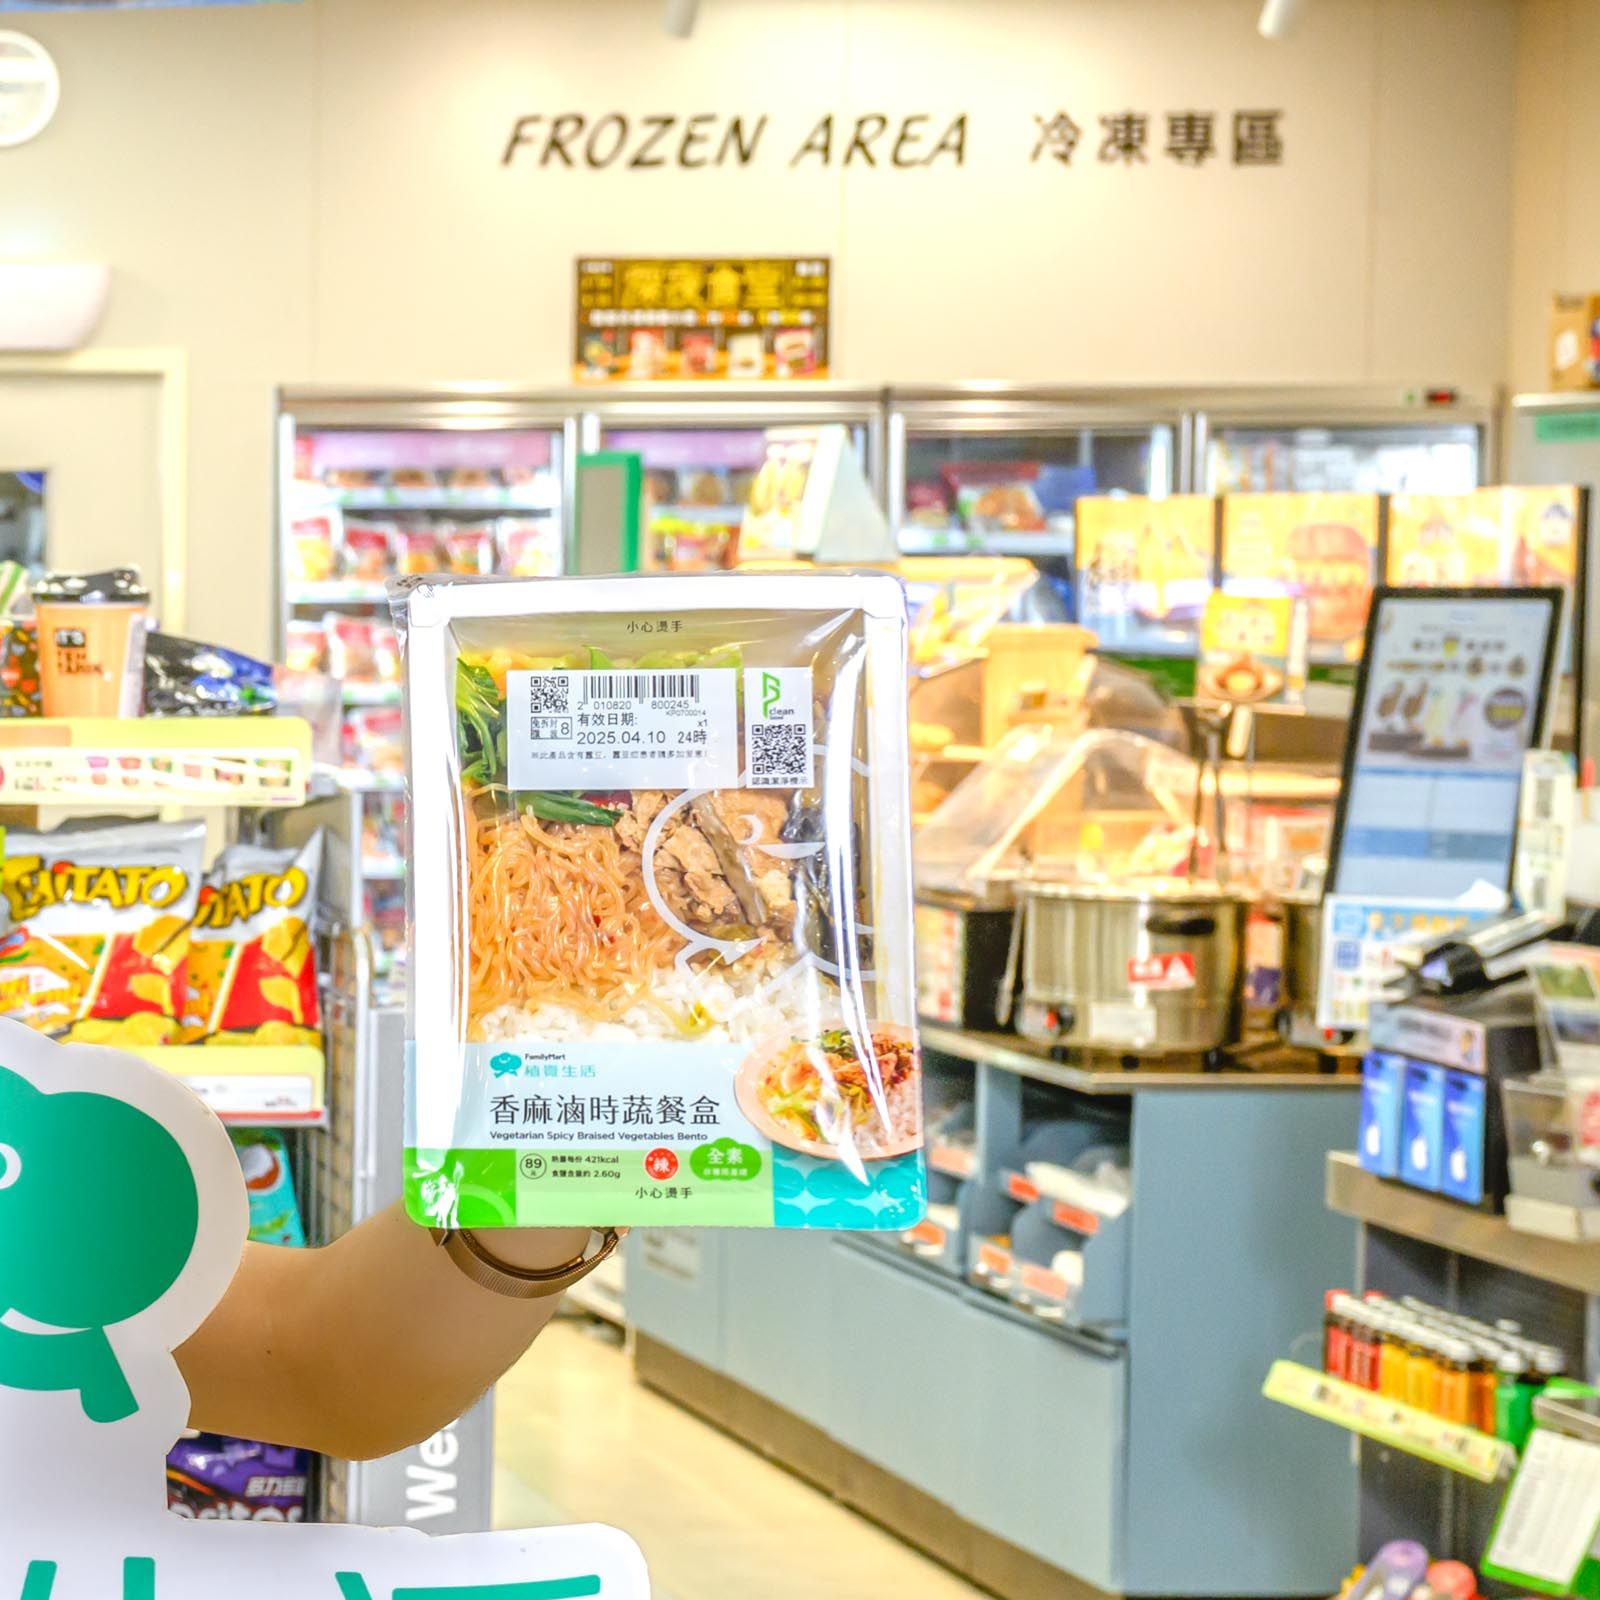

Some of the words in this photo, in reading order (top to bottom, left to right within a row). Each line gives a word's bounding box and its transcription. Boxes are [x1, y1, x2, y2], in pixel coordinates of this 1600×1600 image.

[501, 112, 769, 170] FROZEN
[789, 112, 971, 169] AREA
[1029, 110, 1286, 168] 冷凍專區
[576, 712, 639, 728] 有效日期:
[576, 730, 666, 745] 2025.04.10
[677, 730, 708, 745] 24時
[524, 1052, 567, 1062] FamilyMart
[489, 1093, 722, 1127] 香麻滷時蔬餐盒
[489, 1130, 545, 1142] Vegetarian
[546, 1130, 574, 1142] Spicy
[577, 1130, 616, 1141] Braised
[618, 1131, 675, 1142] Vegetables
[677, 1131, 709, 1142] Bento
[524, 1158, 543, 1170] 89
[706, 1147, 744, 1166] 全素
